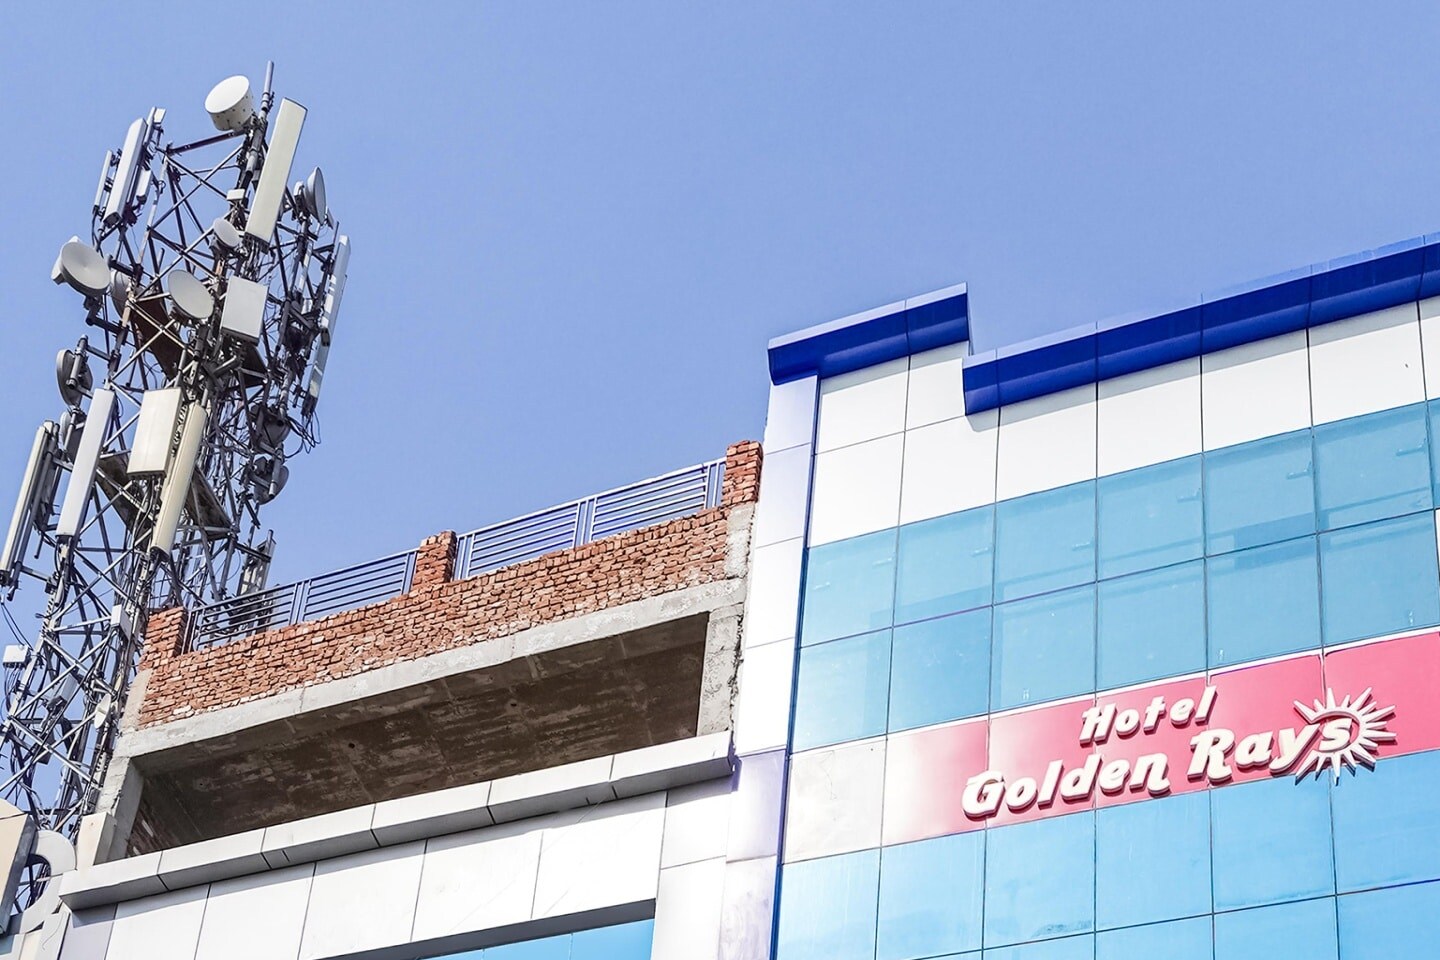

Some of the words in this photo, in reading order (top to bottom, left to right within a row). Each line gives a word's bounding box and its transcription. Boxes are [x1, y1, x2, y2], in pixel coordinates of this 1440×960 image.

[1080, 686, 1217, 745] Hotel
[961, 754, 1170, 820] Golden
[1187, 717, 1354, 787] Rays
